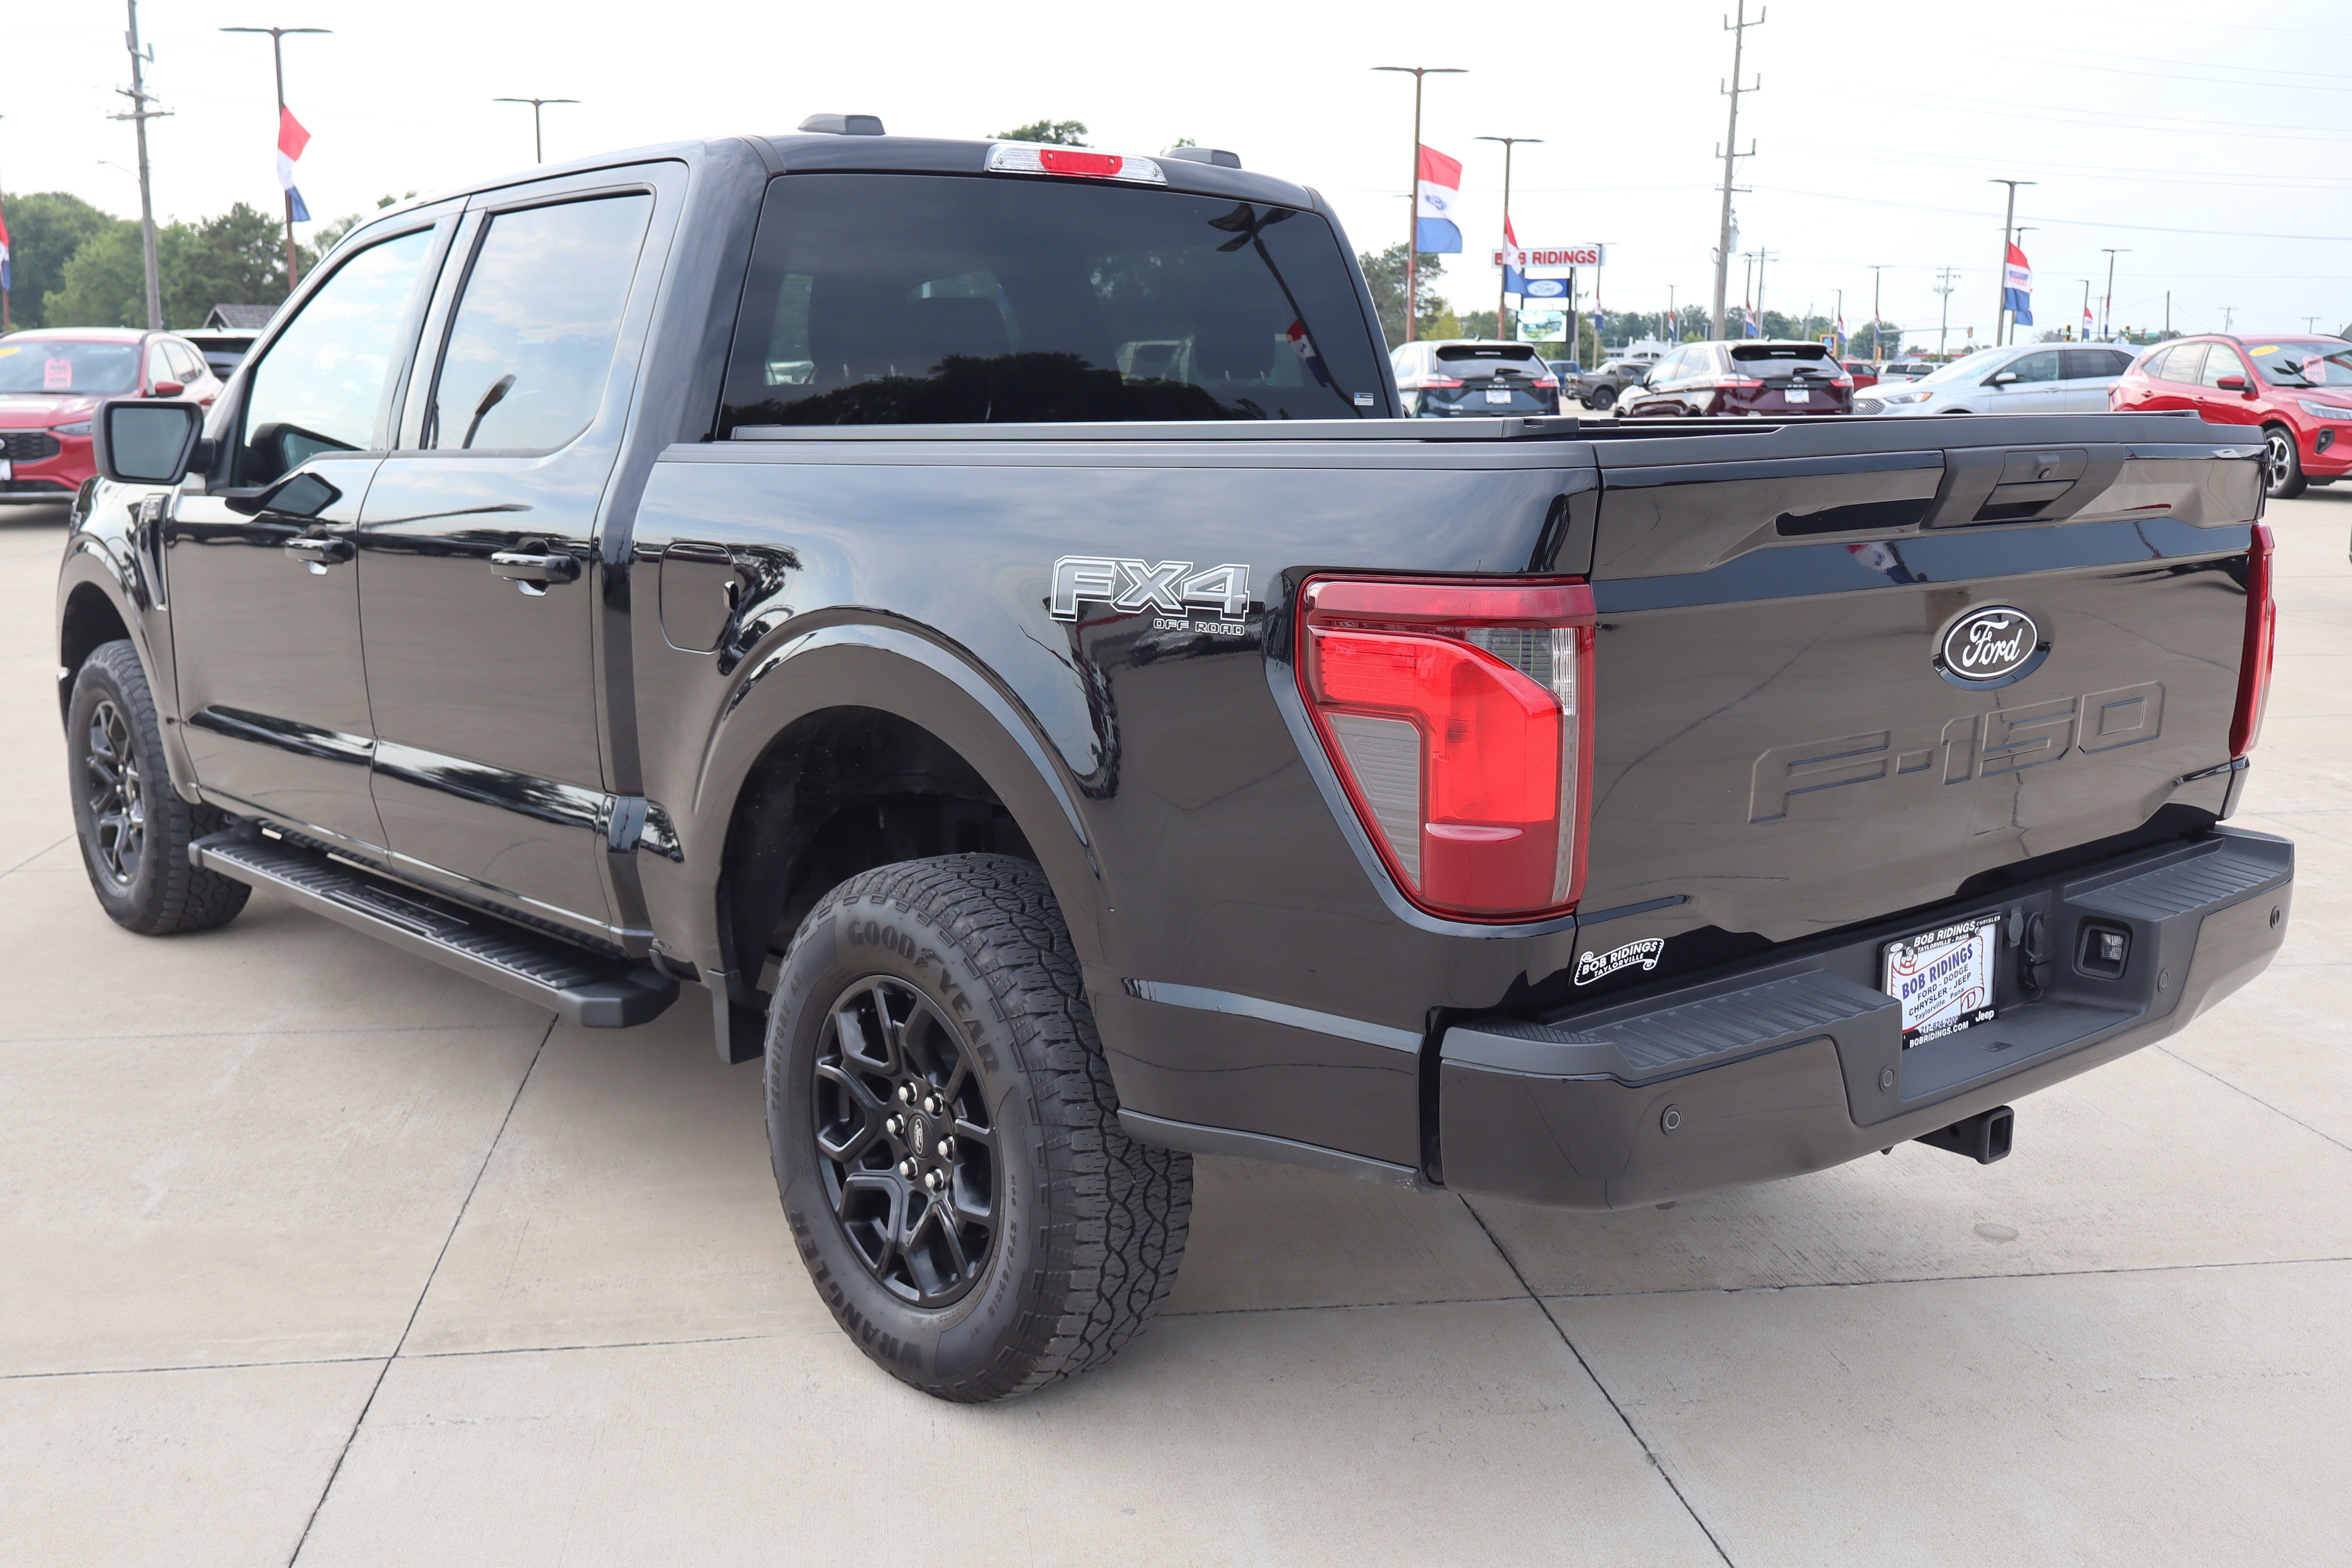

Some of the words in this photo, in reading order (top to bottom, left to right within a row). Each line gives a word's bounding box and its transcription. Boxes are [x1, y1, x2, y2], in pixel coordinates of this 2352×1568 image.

[1532, 250, 1597, 265] RIDINGS
[1049, 555, 1250, 622] FX4
[1153, 618, 1189, 631] OFF
[1195, 621, 1245, 636] ROAD
[1962, 620, 2023, 668] Ford
[1358, 740, 1417, 755] FORD
[1748, 680, 2166, 824] F-150
[1913, 933, 1935, 948] BOB
[1936, 921, 1976, 941] RIDINGS
[1976, 915, 2000, 927] CHRYSLER
[1582, 957, 1607, 975] BOB
[1610, 941, 1658, 964] RIDINGS
[1917, 939, 1951, 953] TAYLORVILLE
[1955, 933, 1969, 942] PANA
[1594, 953, 1644, 977] TAYLORVILLE
[1902, 973, 1925, 1000] BOB
[1929, 943, 1973, 983] RIDINGS
[1909, 987, 1947, 1016] CHRYSLER
[1954, 972, 1971, 988] JEEP
[1918, 983, 1937, 1001] FORD
[1944, 964, 1969, 985] DODGE
[1915, 1000, 1945, 1021] Taylorville
[1950, 987, 1964, 999] Pana
[1975, 1010, 1994, 1022] Jeep
[1909, 1021, 1969, 1048] BOBRIDINGS.COM
[790, 1209, 924, 1369] WRANGLER
